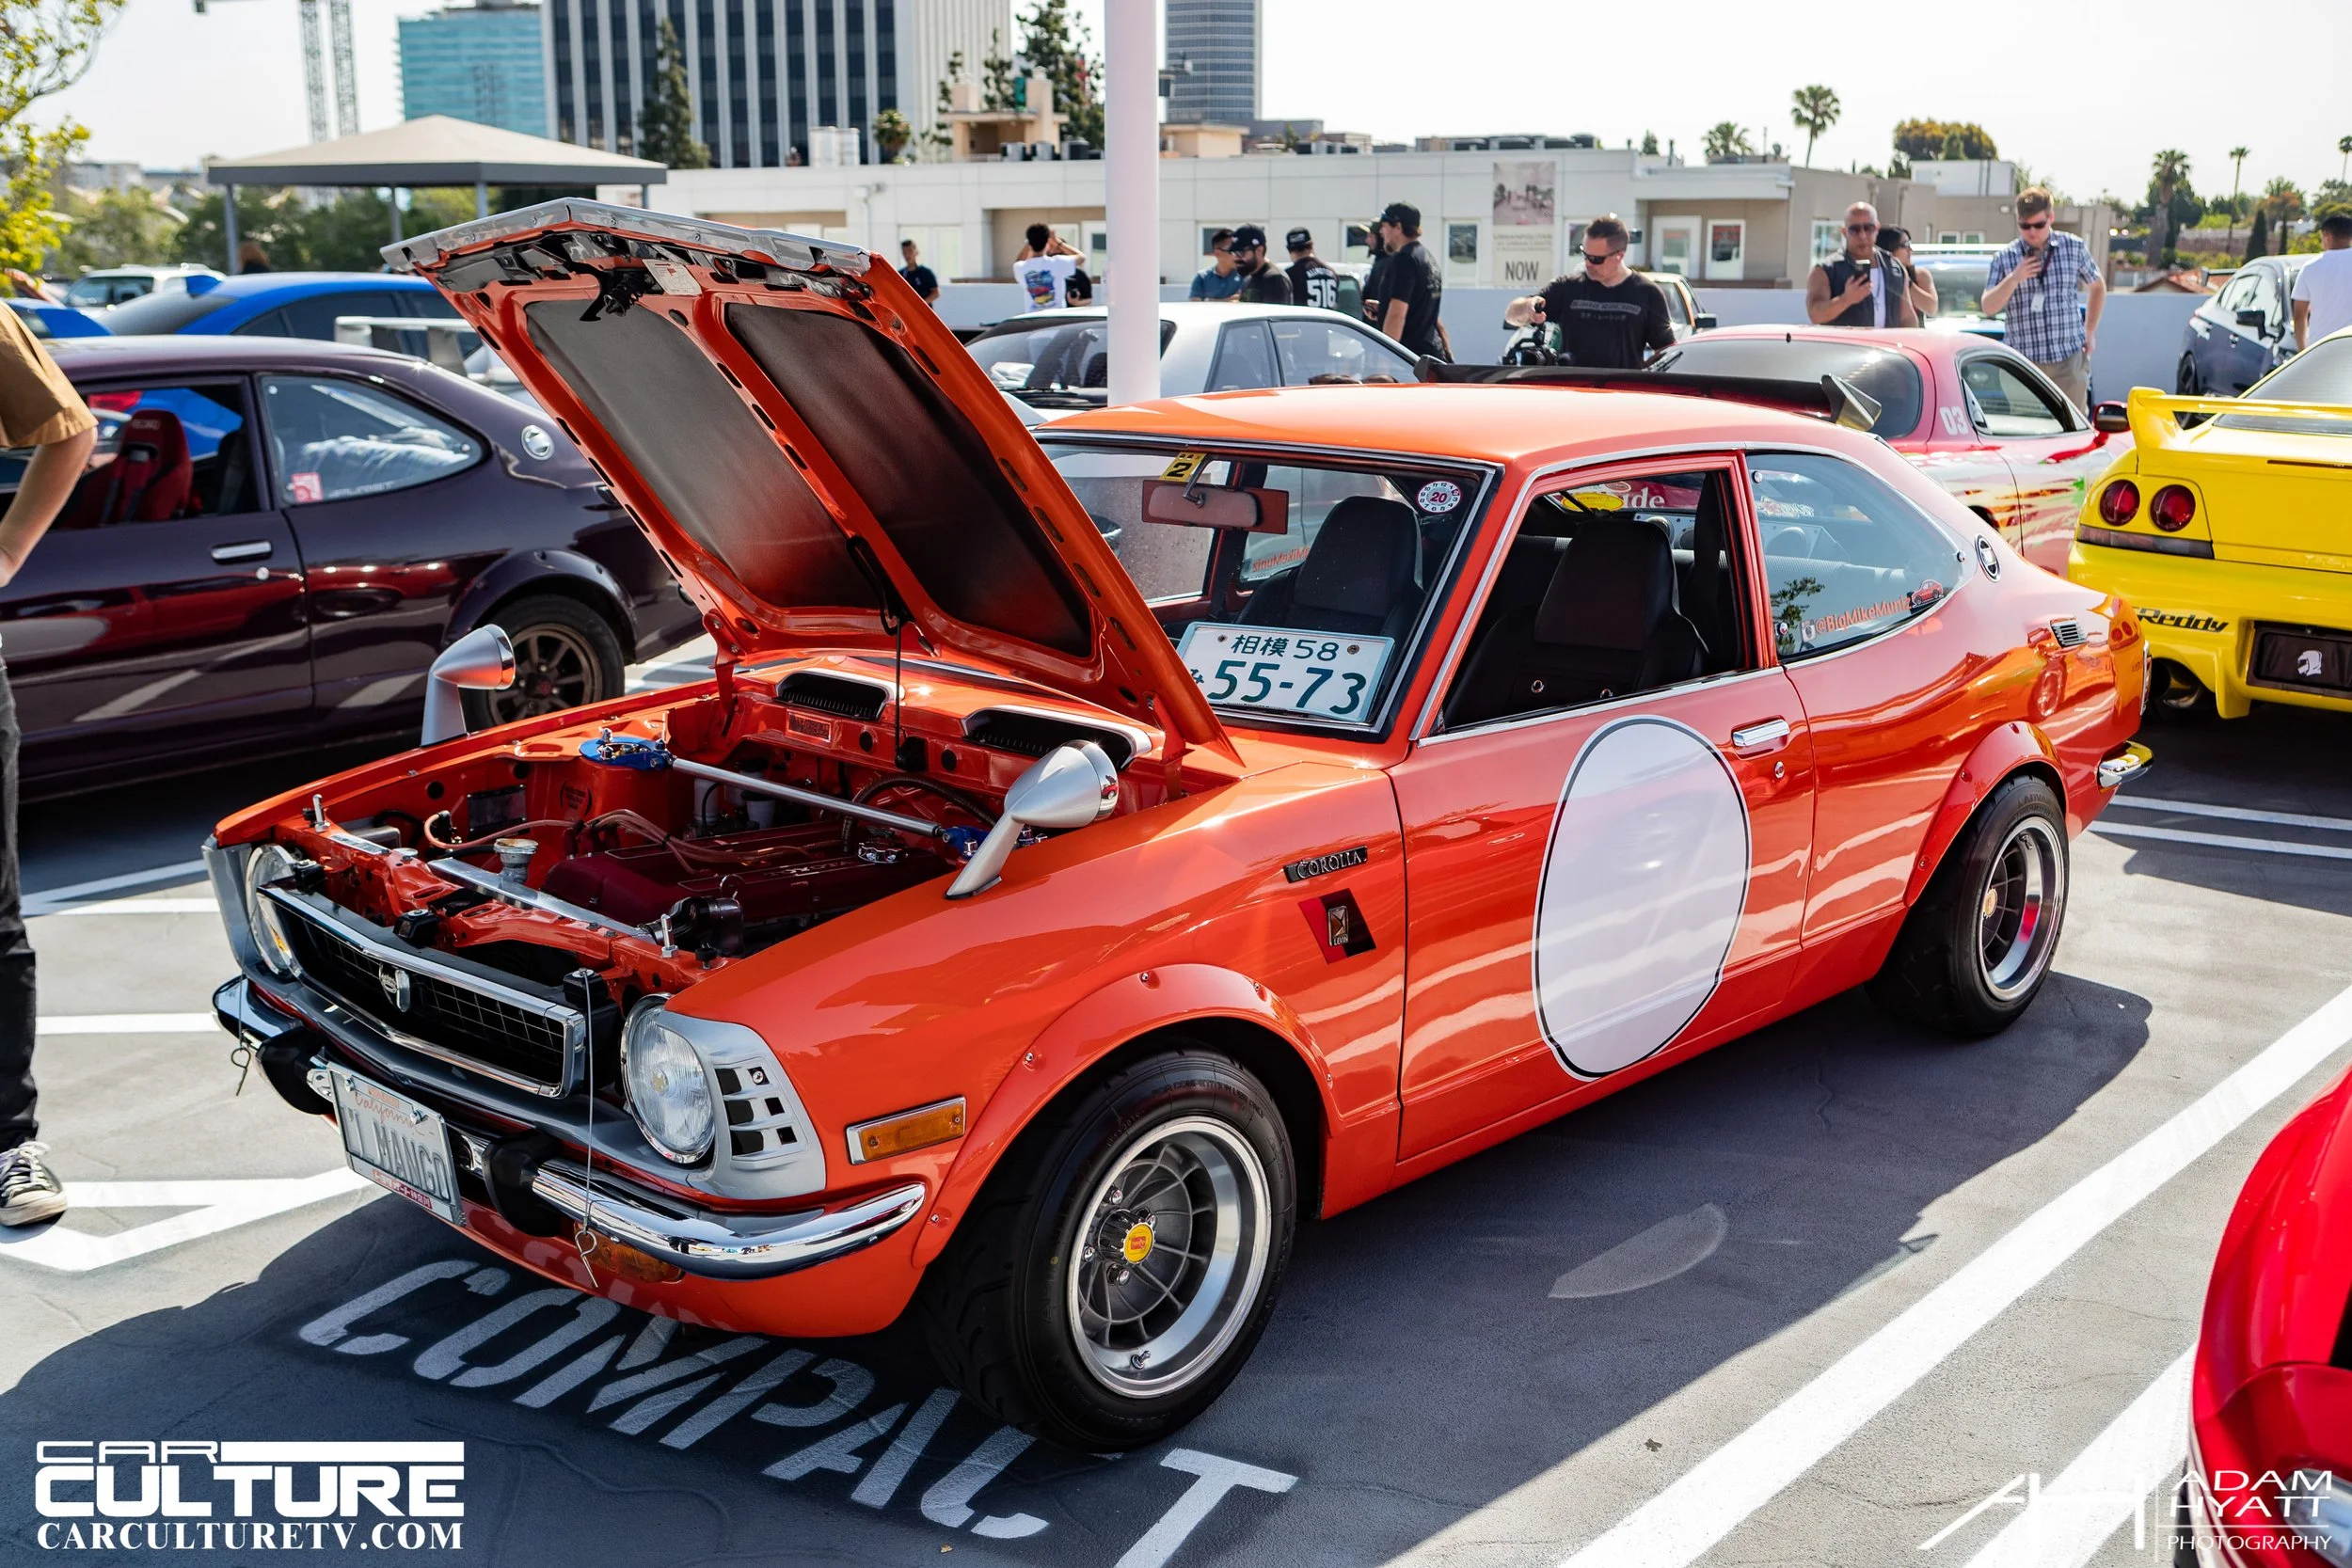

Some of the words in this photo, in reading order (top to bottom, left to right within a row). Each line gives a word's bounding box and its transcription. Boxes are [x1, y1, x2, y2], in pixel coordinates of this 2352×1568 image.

[1505, 261, 1539, 280] NOW
[1307, 278, 1337, 309] 516
[1939, 405, 1969, 436] 03
[1167, 462, 1193, 478] 2
[1430, 492, 1447, 502] 20
[1816, 595, 1912, 635] @BigMikeMuniz
[2132, 607, 2229, 633] Reddy
[1231, 635, 1290, 657] 相模
[1293, 639, 1340, 661] 58
[1207, 660, 1367, 715] 55-73
[1296, 850, 1363, 879] COROLLA
[372, 1119, 452, 1203] MANGO
[298, 1259, 1297, 1568] COMPACT
